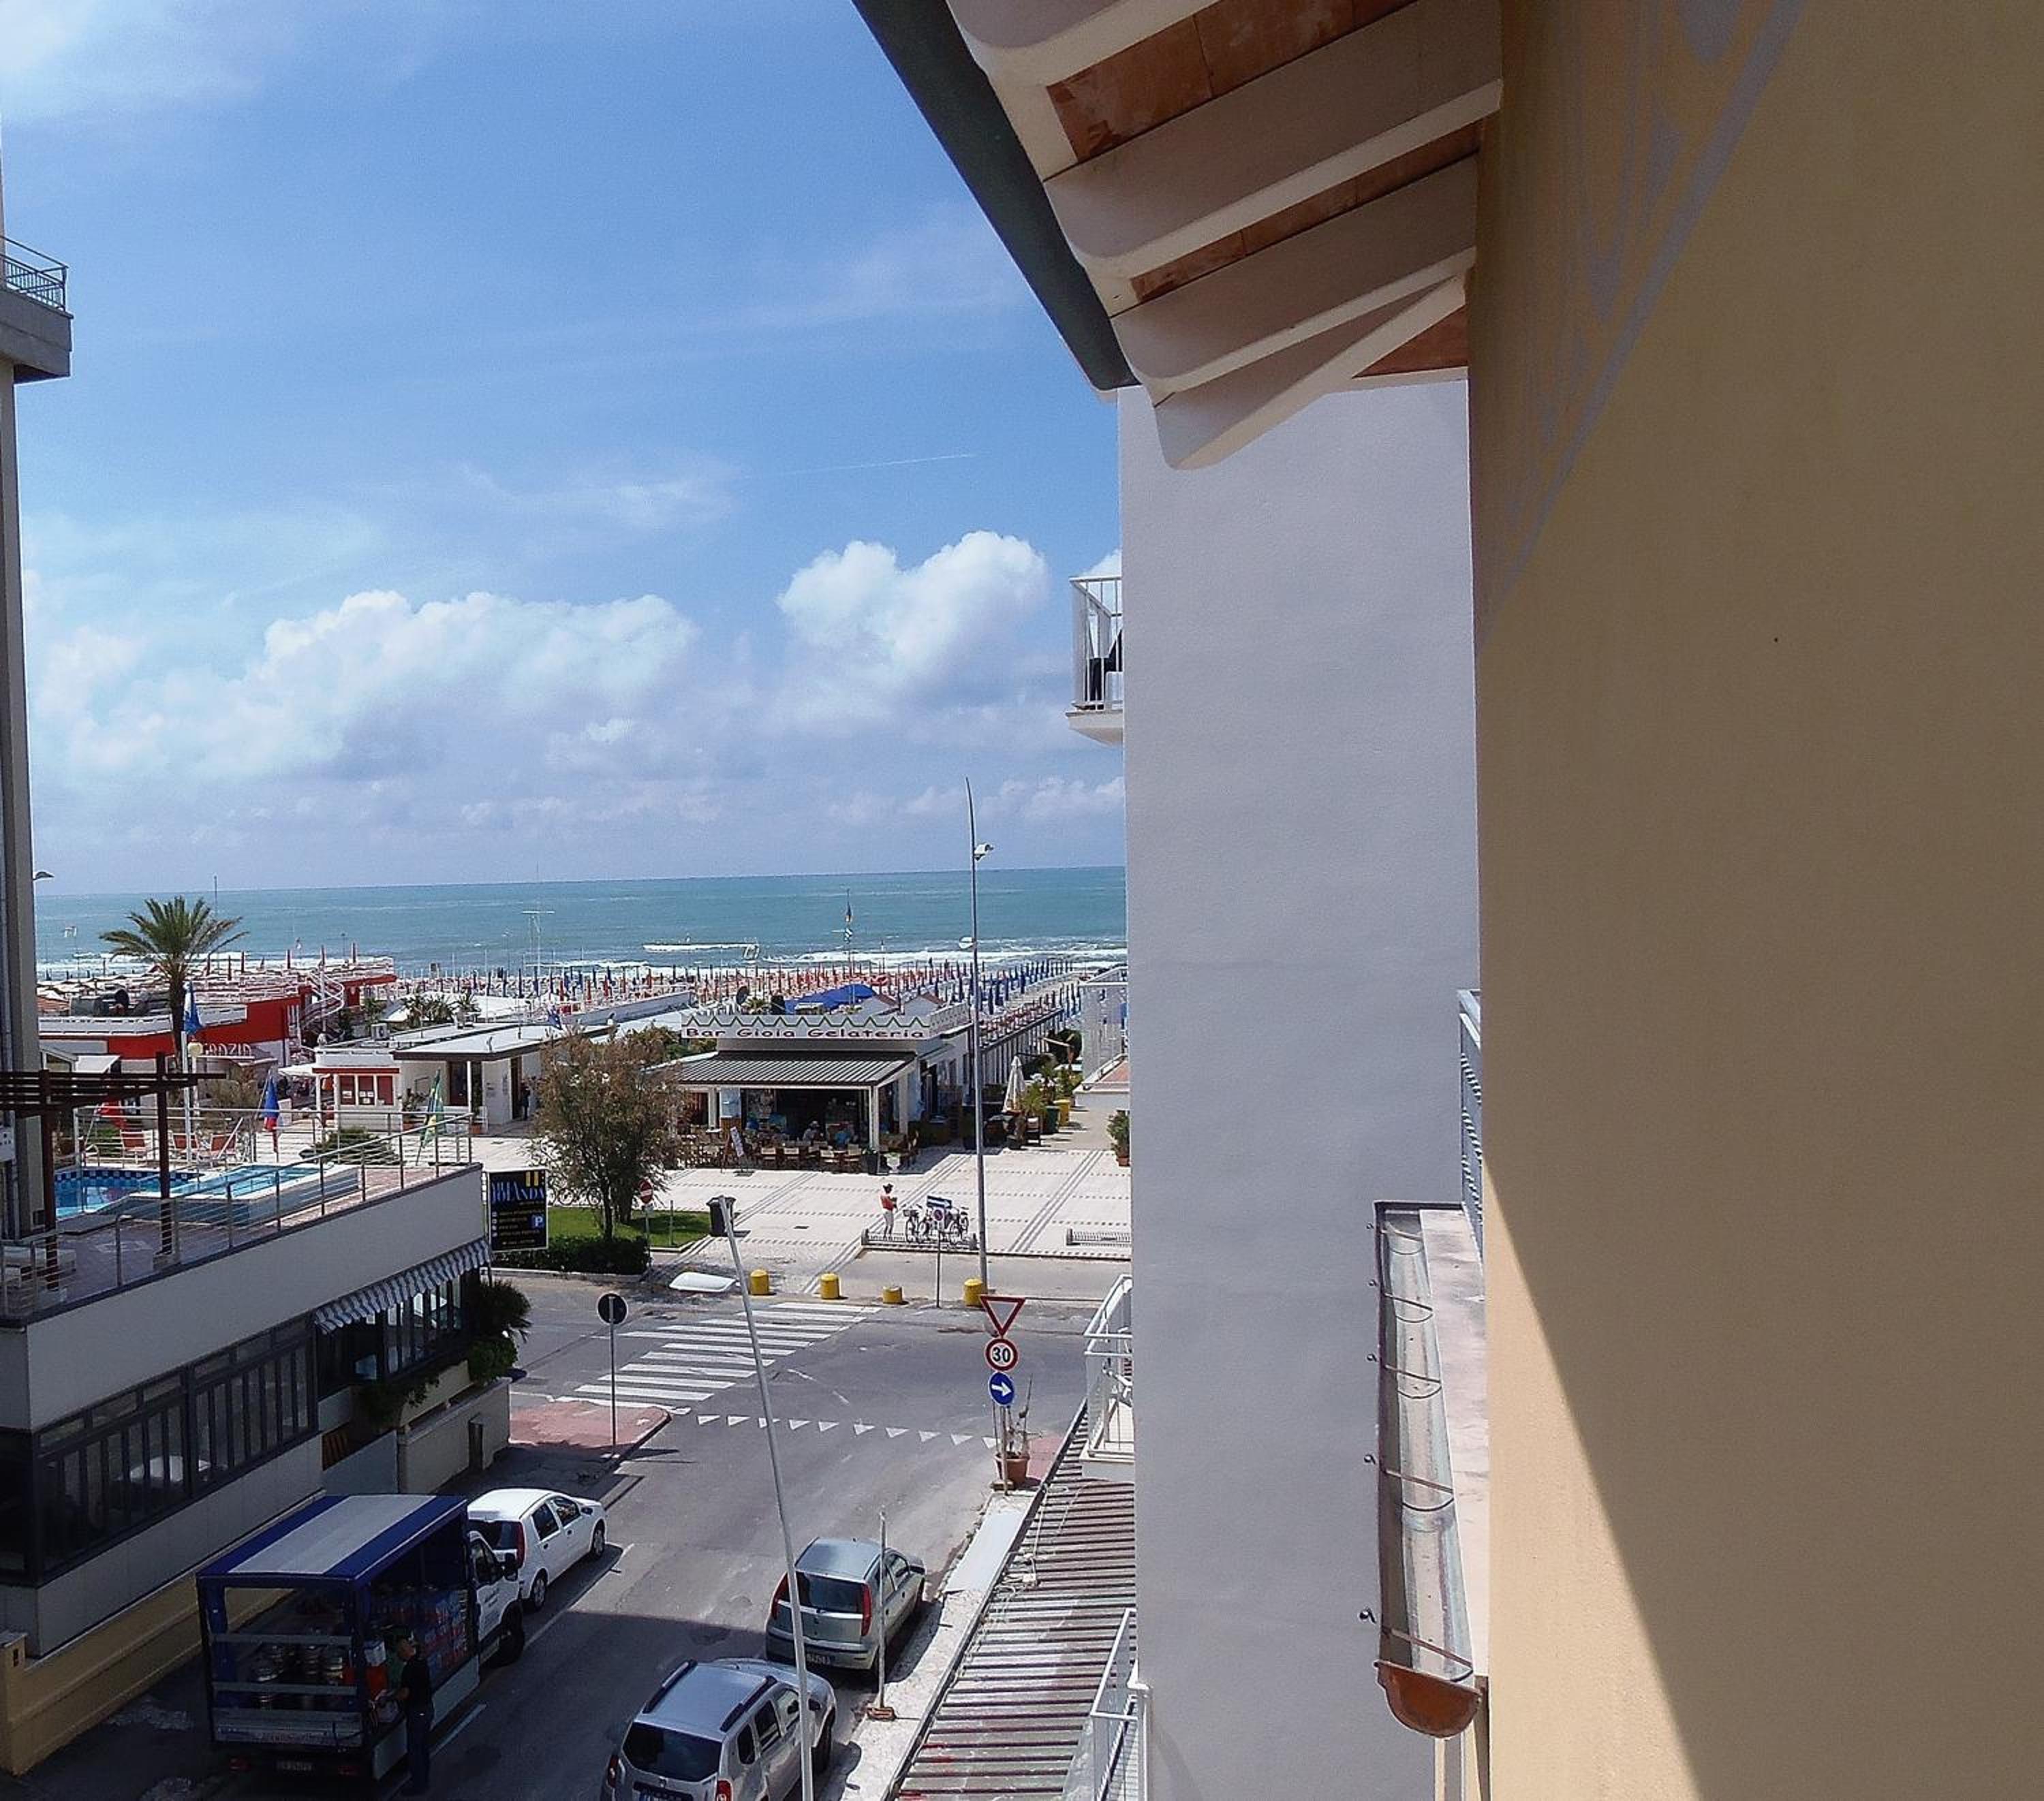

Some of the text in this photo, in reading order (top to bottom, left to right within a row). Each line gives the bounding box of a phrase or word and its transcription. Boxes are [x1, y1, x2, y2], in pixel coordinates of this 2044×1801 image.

[685, 1028, 924, 1038] Bar Gioia Gelateria
[993, 1347, 1010, 1362] 30
